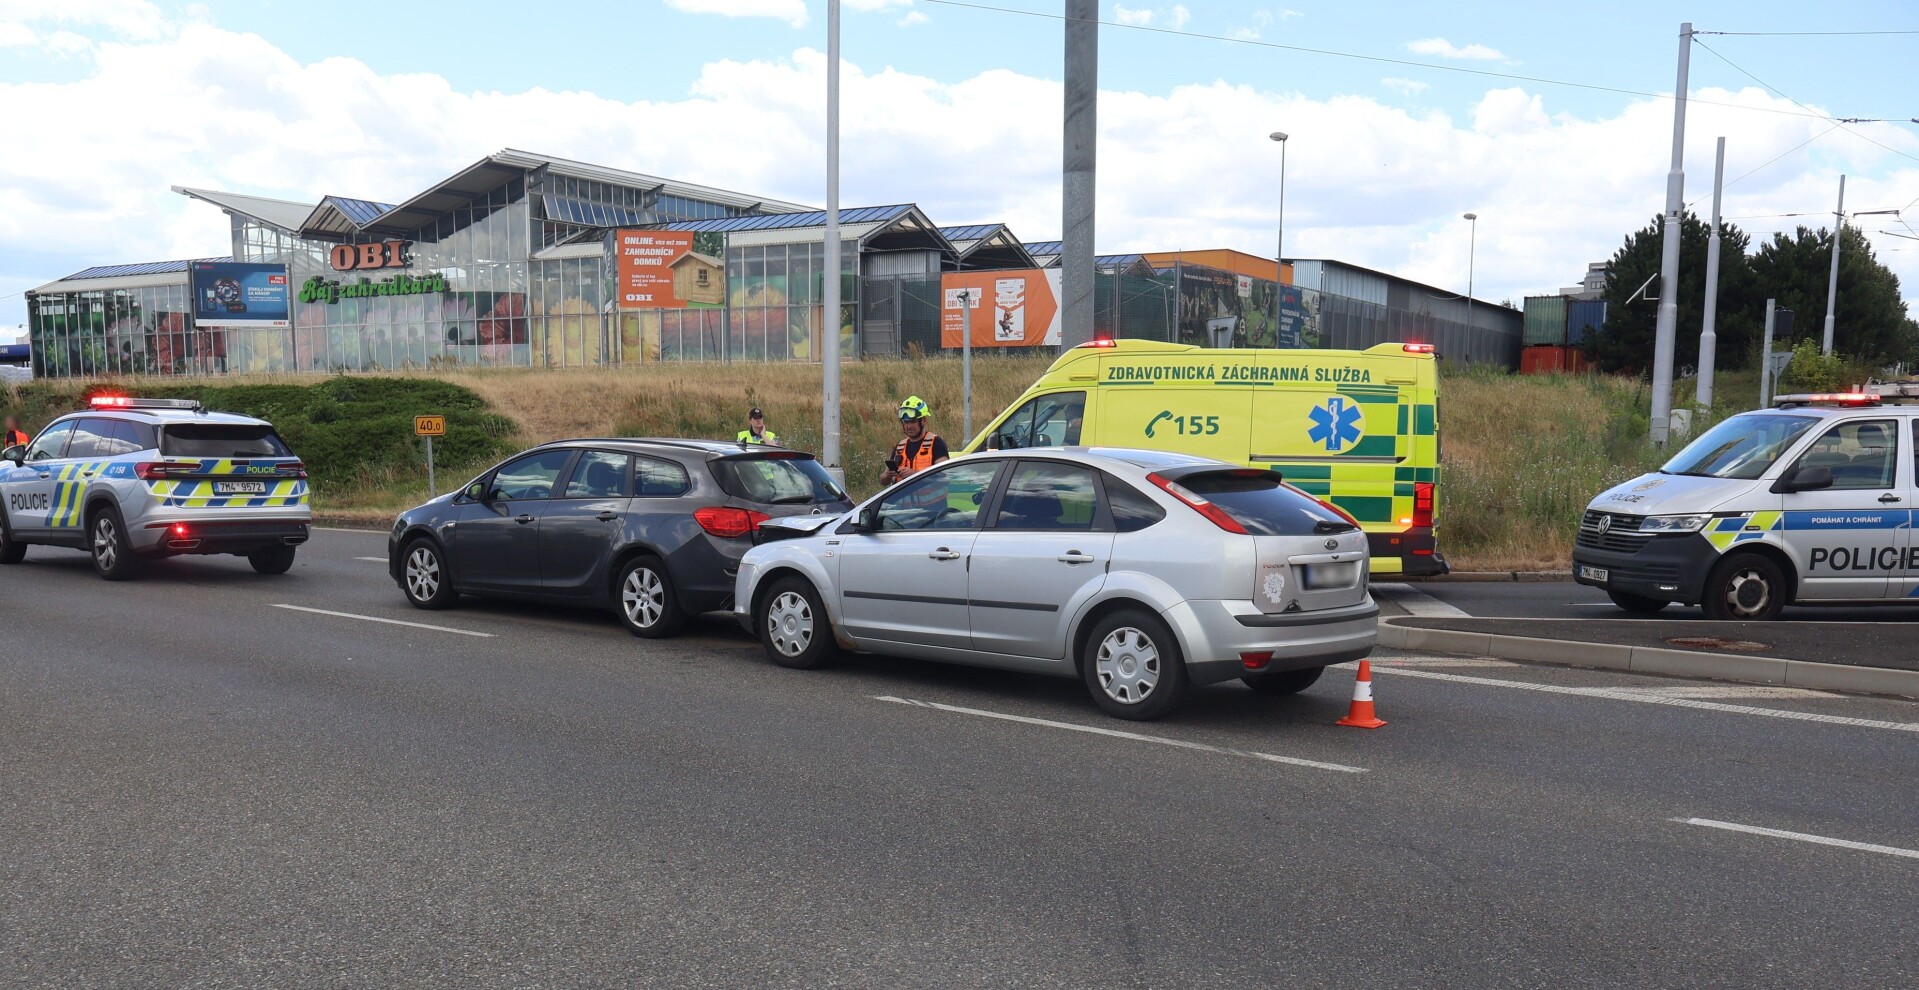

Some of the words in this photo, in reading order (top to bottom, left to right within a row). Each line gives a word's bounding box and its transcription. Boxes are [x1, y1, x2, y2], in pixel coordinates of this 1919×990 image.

[624, 237, 654, 245] ONLINE
[330, 240, 408, 272] OBI
[624, 247, 674, 256] ZAHRADNÍCH
[633, 256, 663, 266] DOMKŮ
[298, 276, 335, 304] Ráj
[625, 293, 653, 302] OBI
[1107, 364, 1215, 380] ZDRAVOTNICKÁ
[1221, 364, 1309, 381] ZÁCHRANNÁ
[1314, 365, 1371, 383] SLUŽBA
[1173, 415, 1220, 435] 155
[114, 466, 125, 474] 158
[220, 483, 236, 492] 7M4
[241, 483, 262, 491] 9572
[11, 493, 49, 510] POLICIE
[1607, 493, 1646, 503] POLICIE
[1811, 515, 1846, 524] POMÁHAT
[1852, 515, 1883, 523] CHRÁNIT
[1809, 547, 1919, 571] POLICIE
